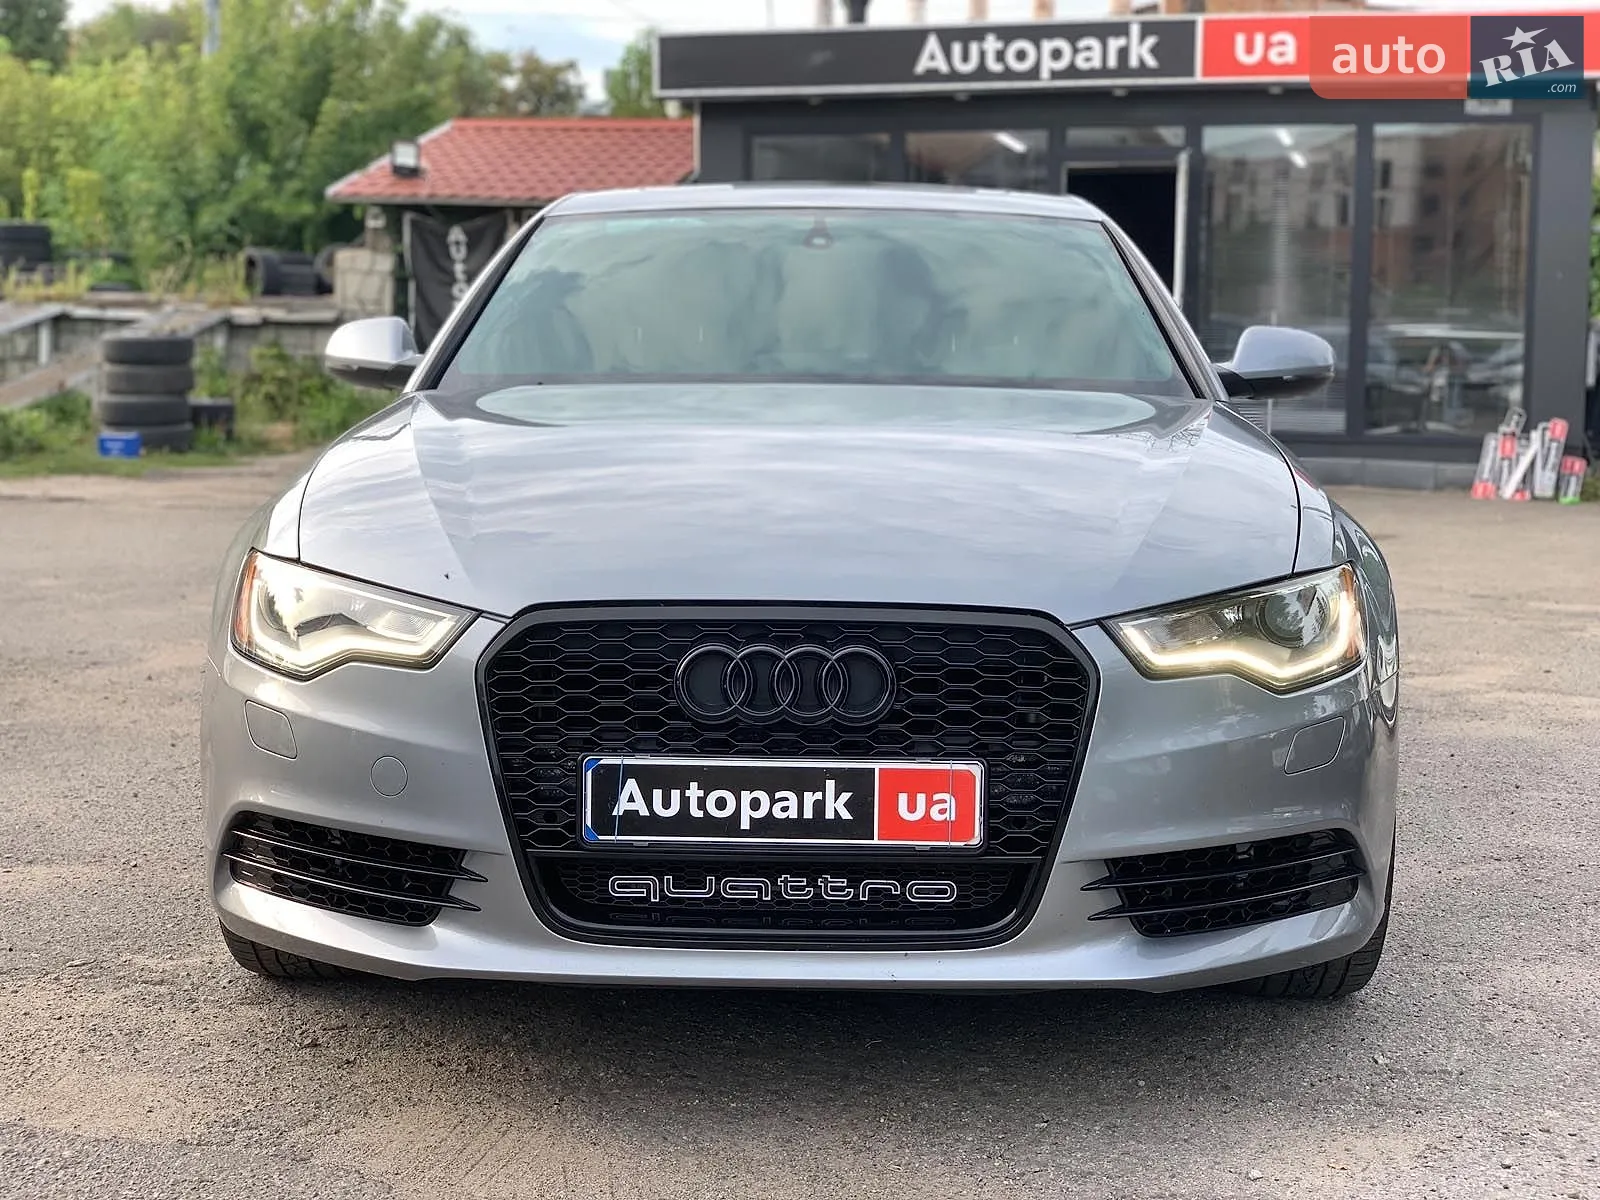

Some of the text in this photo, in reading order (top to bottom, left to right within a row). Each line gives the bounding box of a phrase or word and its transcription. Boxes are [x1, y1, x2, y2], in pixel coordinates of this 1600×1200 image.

[913, 22, 1298, 80] Autopark ua
[611, 777, 957, 830] Autopark ua
[608, 874, 957, 903] quattro
